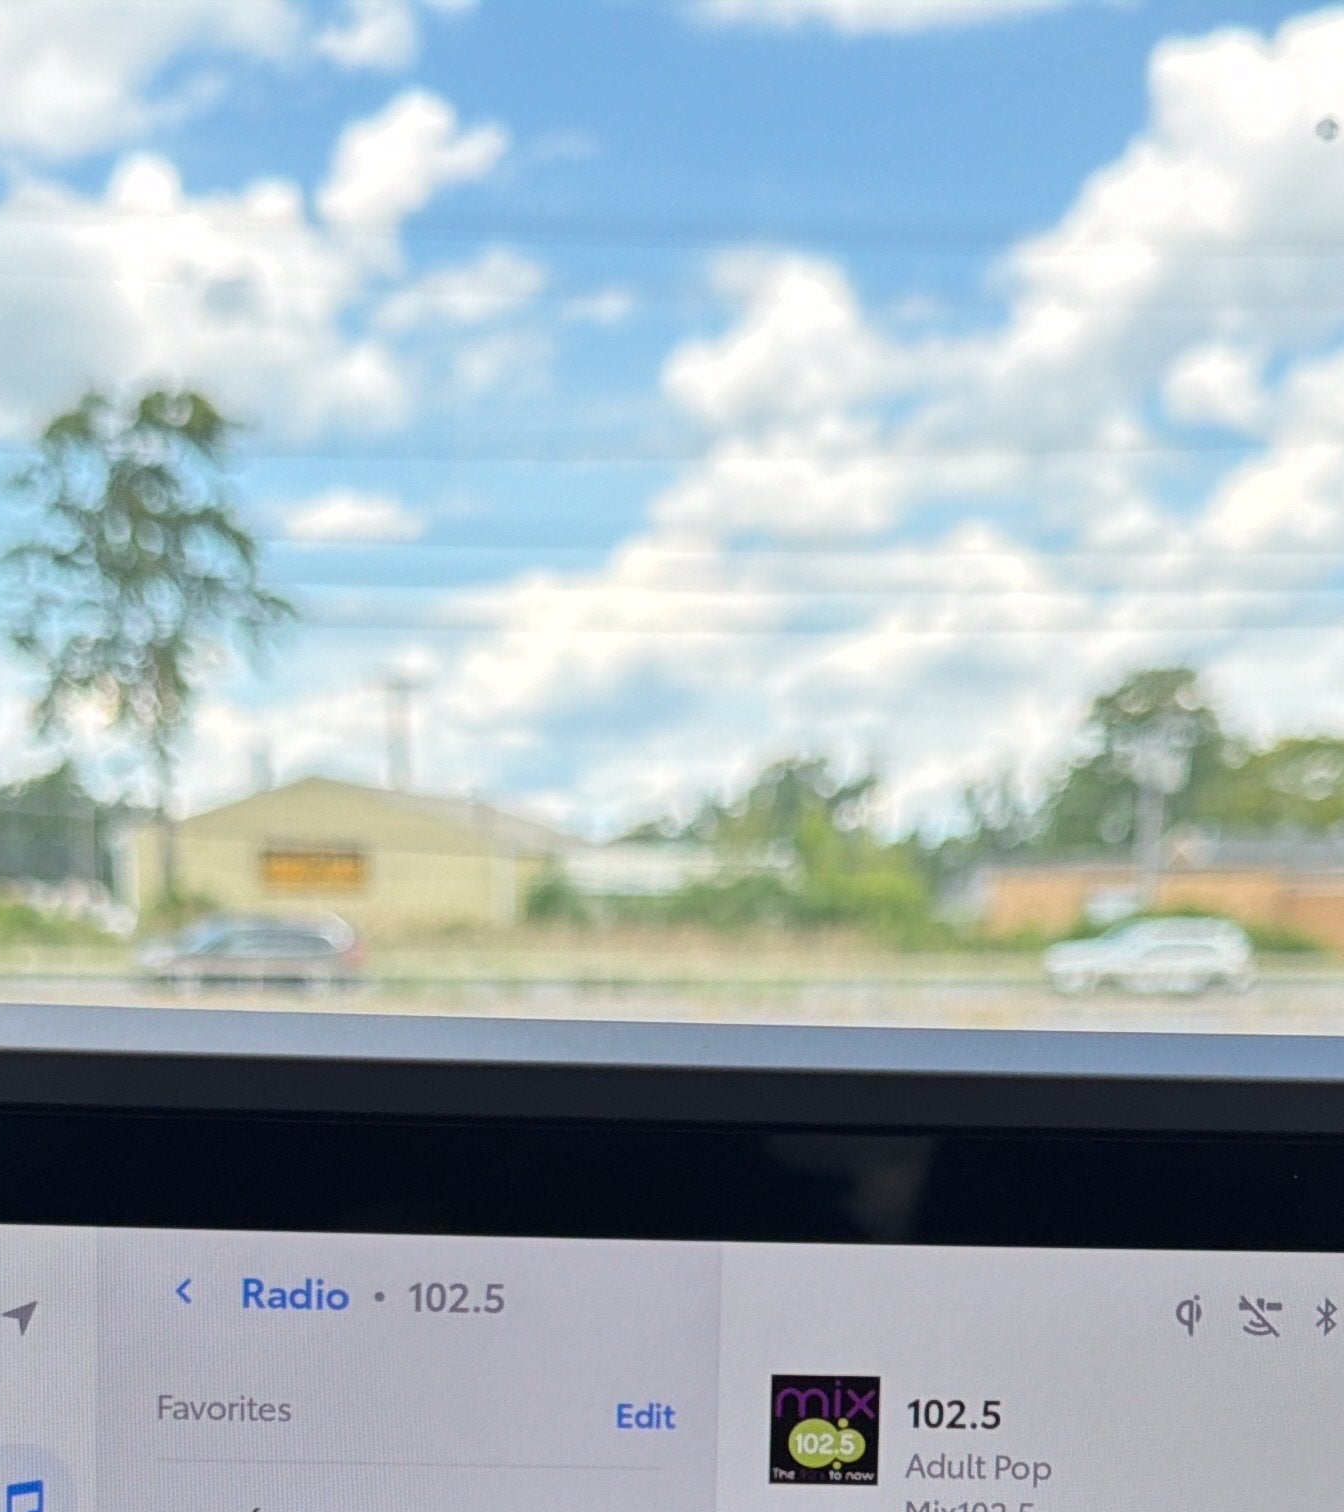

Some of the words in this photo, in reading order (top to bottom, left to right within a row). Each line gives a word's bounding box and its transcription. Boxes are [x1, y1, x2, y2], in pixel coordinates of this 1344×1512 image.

[241, 1277, 351, 1312] Radio
[408, 1283, 506, 1315] 102.5
[157, 1394, 292, 1424] Favorites
[615, 1403, 676, 1431] Edit
[775, 1380, 876, 1419] mix
[906, 1399, 1002, 1431] 102.5
[795, 1432, 856, 1456] 102.5
[905, 1453, 988, 1483] Adult
[994, 1455, 1053, 1490] Pop
